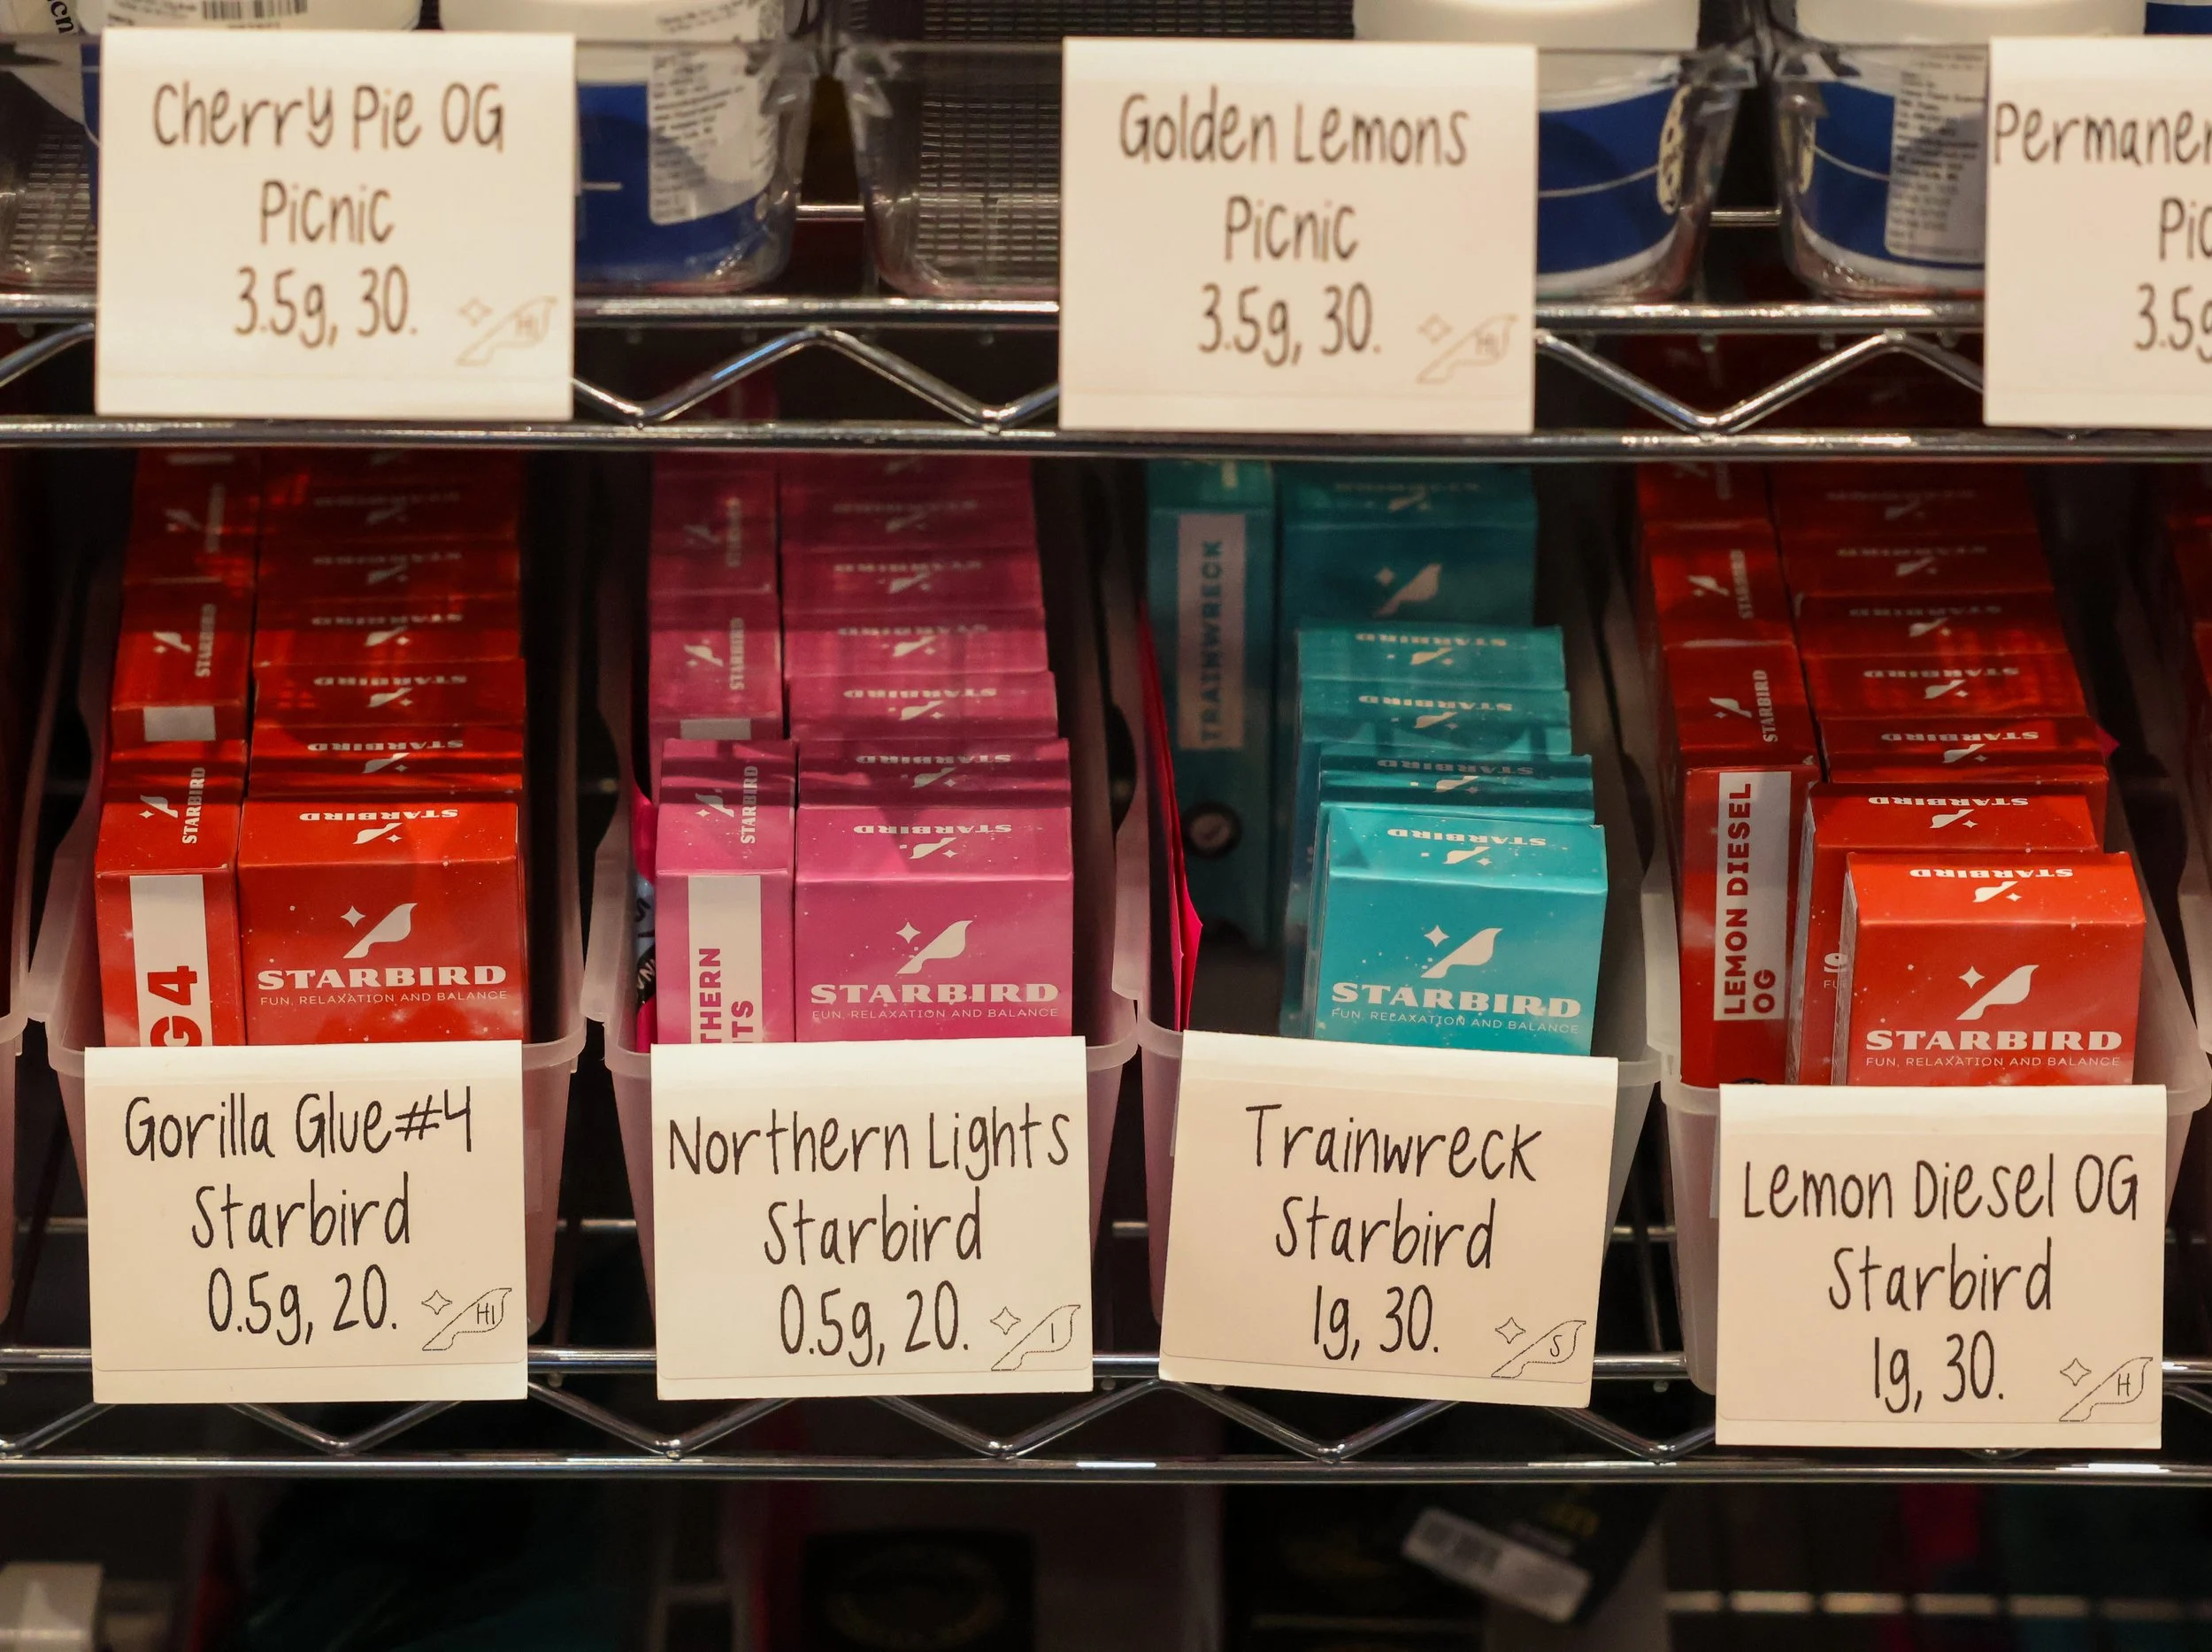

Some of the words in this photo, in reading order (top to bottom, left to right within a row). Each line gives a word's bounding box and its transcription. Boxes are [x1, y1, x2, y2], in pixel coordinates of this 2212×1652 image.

[153, 81, 334, 149] Cherry
[353, 85, 421, 150] Pie
[442, 82, 504, 152] OG
[1120, 86, 1276, 163] Golden
[1294, 104, 1468, 166] Lemons
[260, 179, 394, 244] Picnic
[1225, 195, 1358, 262] Picnic
[235, 265, 337, 350] 3.5g,
[357, 264, 417, 338] 30.
[1199, 283, 1302, 367] 3.5g,
[1321, 281, 1379, 356] 30.
[1202, 540, 1222, 742] TRAINWRECK
[1753, 670, 1778, 741] STARBIRD
[1882, 732, 2039, 741] STARBIRD
[181, 766, 204, 844] STARBIRD
[300, 810, 457, 820] STARBIRD
[740, 765, 757, 844] STARBIRD
[854, 825, 1011, 834] STARBIRD
[1869, 797, 2028, 806] STARBIRD
[1387, 829, 1547, 846] STARBIRD
[1727, 784, 1750, 895] DIESEL
[1910, 869, 2073, 878] STARBIRD
[258, 966, 506, 990] STARBIRD
[811, 984, 1058, 1003] STARBIRD
[1724, 909, 1747, 1014] LEMON
[1753, 970, 1776, 1013] OG
[261, 997, 293, 1007] FUN,
[300, 994, 394, 1004] RELAXATION
[401, 993, 431, 1002] AND
[437, 991, 507, 1002] BALANCE
[731, 1001, 753, 1042] TS
[851, 1010, 945, 1018] RELAXATION
[987, 1008, 1058, 1018] BALANCE
[1332, 982, 1581, 1018] STARBIRD
[1371, 1011, 1466, 1026] RELAXATION
[1471, 1019, 1502, 1028] AND
[1508, 1021, 1578, 1033] BALANCE
[1866, 1030, 2122, 1050] STARBIRD
[1866, 1057, 1899, 1068] FUN,
[1906, 1056, 2002, 1066] RELAXATION
[2048, 1057, 2120, 1067] BALANCE
[126, 1093, 275, 1161] Gorilla
[670, 1109, 909, 1175] Northern
[929, 1103, 1070, 1181] Lights
[1246, 1104, 1541, 1181] Trainwreck
[192, 1172, 410, 1249] Starbird
[1745, 1162, 1892, 1218] Lemon
[1915, 1153, 2054, 1219] Diesel
[2076, 1155, 2138, 1220] OG
[764, 1187, 981, 1265] Starbird
[1276, 1195, 1495, 1269] Starbird
[209, 1268, 312, 1345] 0.5g,
[334, 1264, 396, 1331] 20.
[1829, 1237, 2051, 1311] Starbird
[780, 1284, 885, 1367] 0.5g,
[905, 1280, 968, 1352] 20.
[1379, 1285, 1438, 1353] 30.
[1943, 1330, 2003, 1402] 30.
[2117, 1373, 2131, 1396] H
